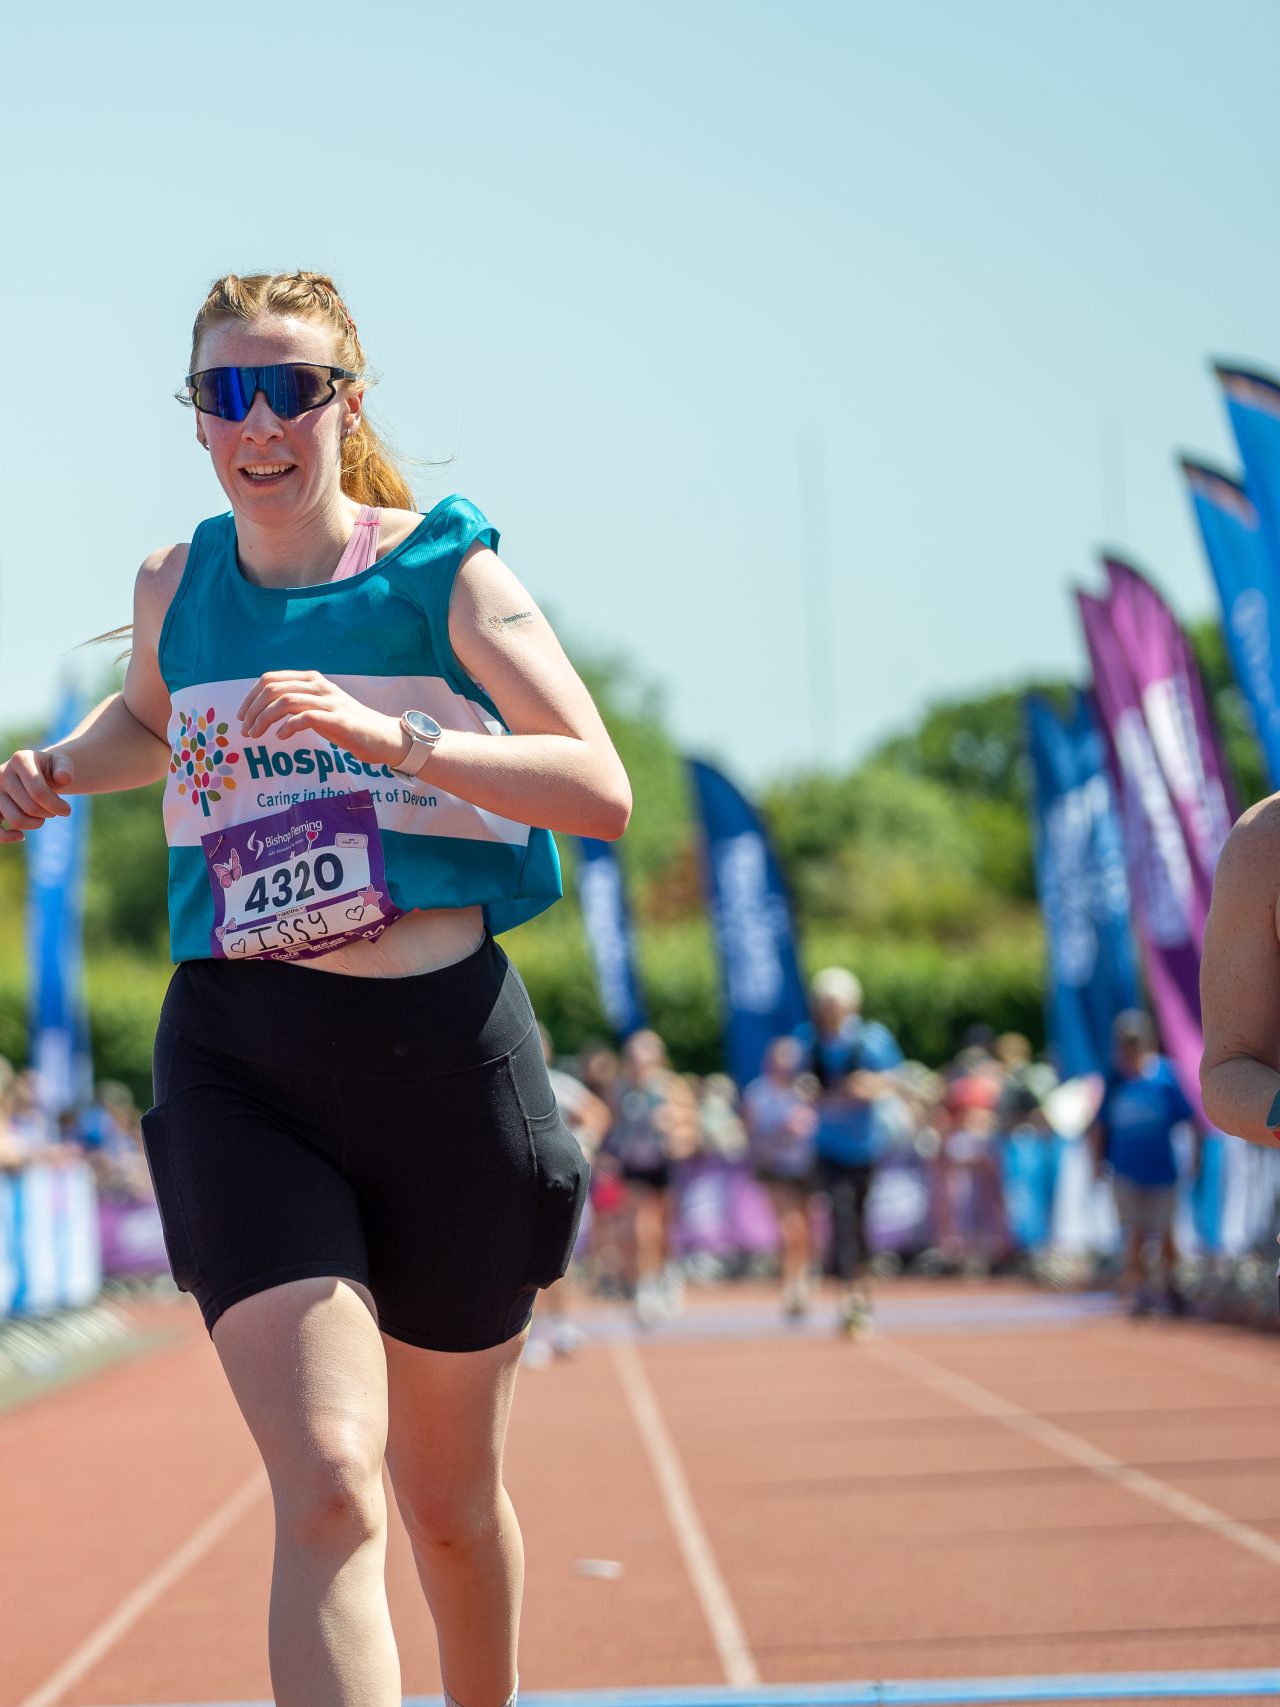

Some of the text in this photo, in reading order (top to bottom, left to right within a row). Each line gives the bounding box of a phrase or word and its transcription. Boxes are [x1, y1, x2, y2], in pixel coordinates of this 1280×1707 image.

[257, 790, 300, 808] Caring
[304, 788, 316, 801] in
[385, 789, 400, 803] of
[402, 790, 437, 808] Devon
[245, 853, 344, 913] 4320
